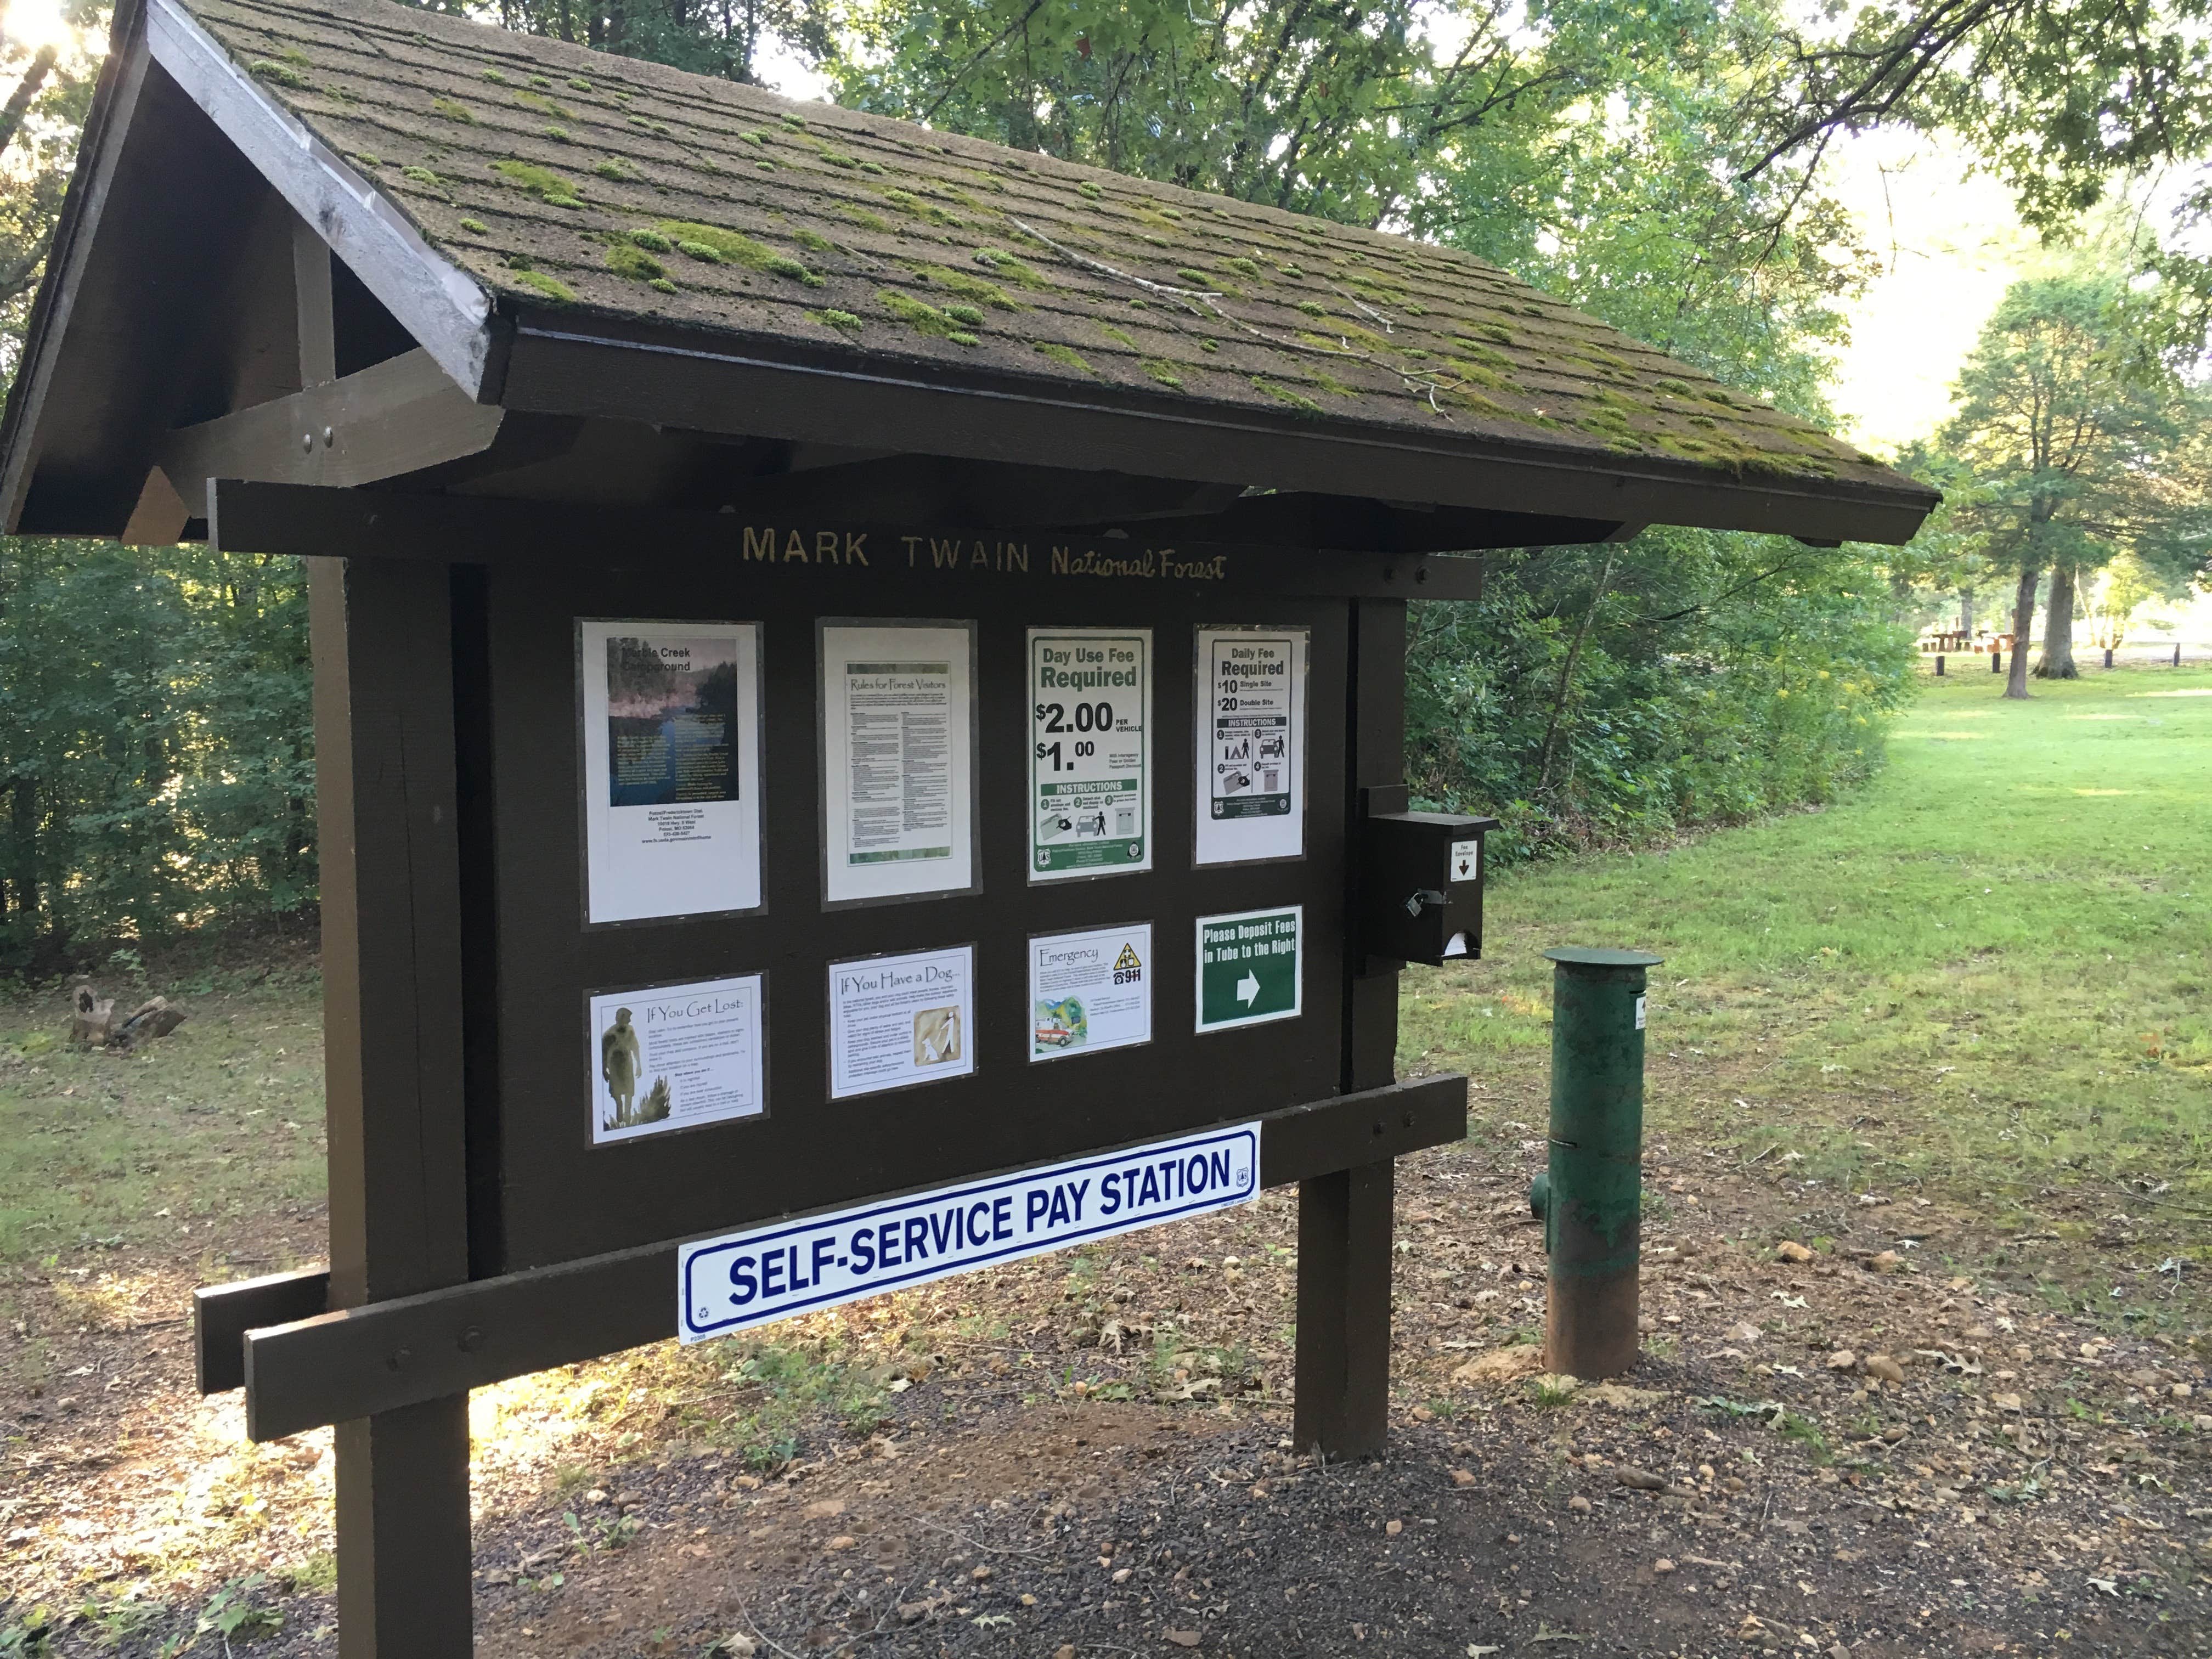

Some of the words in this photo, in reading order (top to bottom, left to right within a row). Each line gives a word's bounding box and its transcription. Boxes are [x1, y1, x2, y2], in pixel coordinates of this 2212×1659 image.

[742, 527, 869, 566] MARK
[901, 535, 1029, 573] TWAIN
[1052, 546, 1155, 578] National
[1160, 549, 1227, 580] Forest
[661, 647, 690, 657] Creek
[1043, 648, 1071, 666] Day
[1076, 647, 1104, 663] Use
[1109, 647, 1134, 662] Fee
[1232, 648, 1255, 660] Daily
[1258, 648, 1274, 658] Fee
[1221, 661, 1284, 678] Required
[851, 678, 873, 691] Rules
[876, 678, 887, 690] for
[889, 678, 913, 690] Forest
[916, 679, 946, 690] Visitors
[1041, 666, 1136, 692] Required
[1217, 680, 1238, 694] $10
[1240, 680, 1259, 689] Single
[1217, 697, 1237, 711] $20
[1036, 702, 1113, 733] $2.00
[1228, 718, 1276, 727] INSTRUCTIONS
[1057, 781, 1122, 794] INSTRUCTIONS
[1204, 928, 1235, 944] Please
[1238, 922, 1272, 940] Deposit
[1276, 920, 1295, 934] Fees
[1040, 949, 1098, 967] Emergency
[1204, 950, 1213, 963] in
[1216, 946, 1238, 962] Tube
[1242, 945, 1251, 958] to
[1254, 941, 1269, 956] the
[1272, 938, 1295, 955] Right
[841, 978, 850, 995] If
[851, 975, 877, 992] You
[881, 972, 912, 989] Have
[916, 974, 922, 982] a
[1125, 969, 1141, 984] 911
[647, 1007, 656, 1023] If
[658, 1006, 683, 1021] You
[686, 1001, 712, 1017] Get
[715, 998, 743, 1013] Lost:
[729, 1196, 1013, 1305] SELF-SERVICE
[1026, 1179, 1091, 1233] PAY
[1100, 1149, 1229, 1215] STATION
